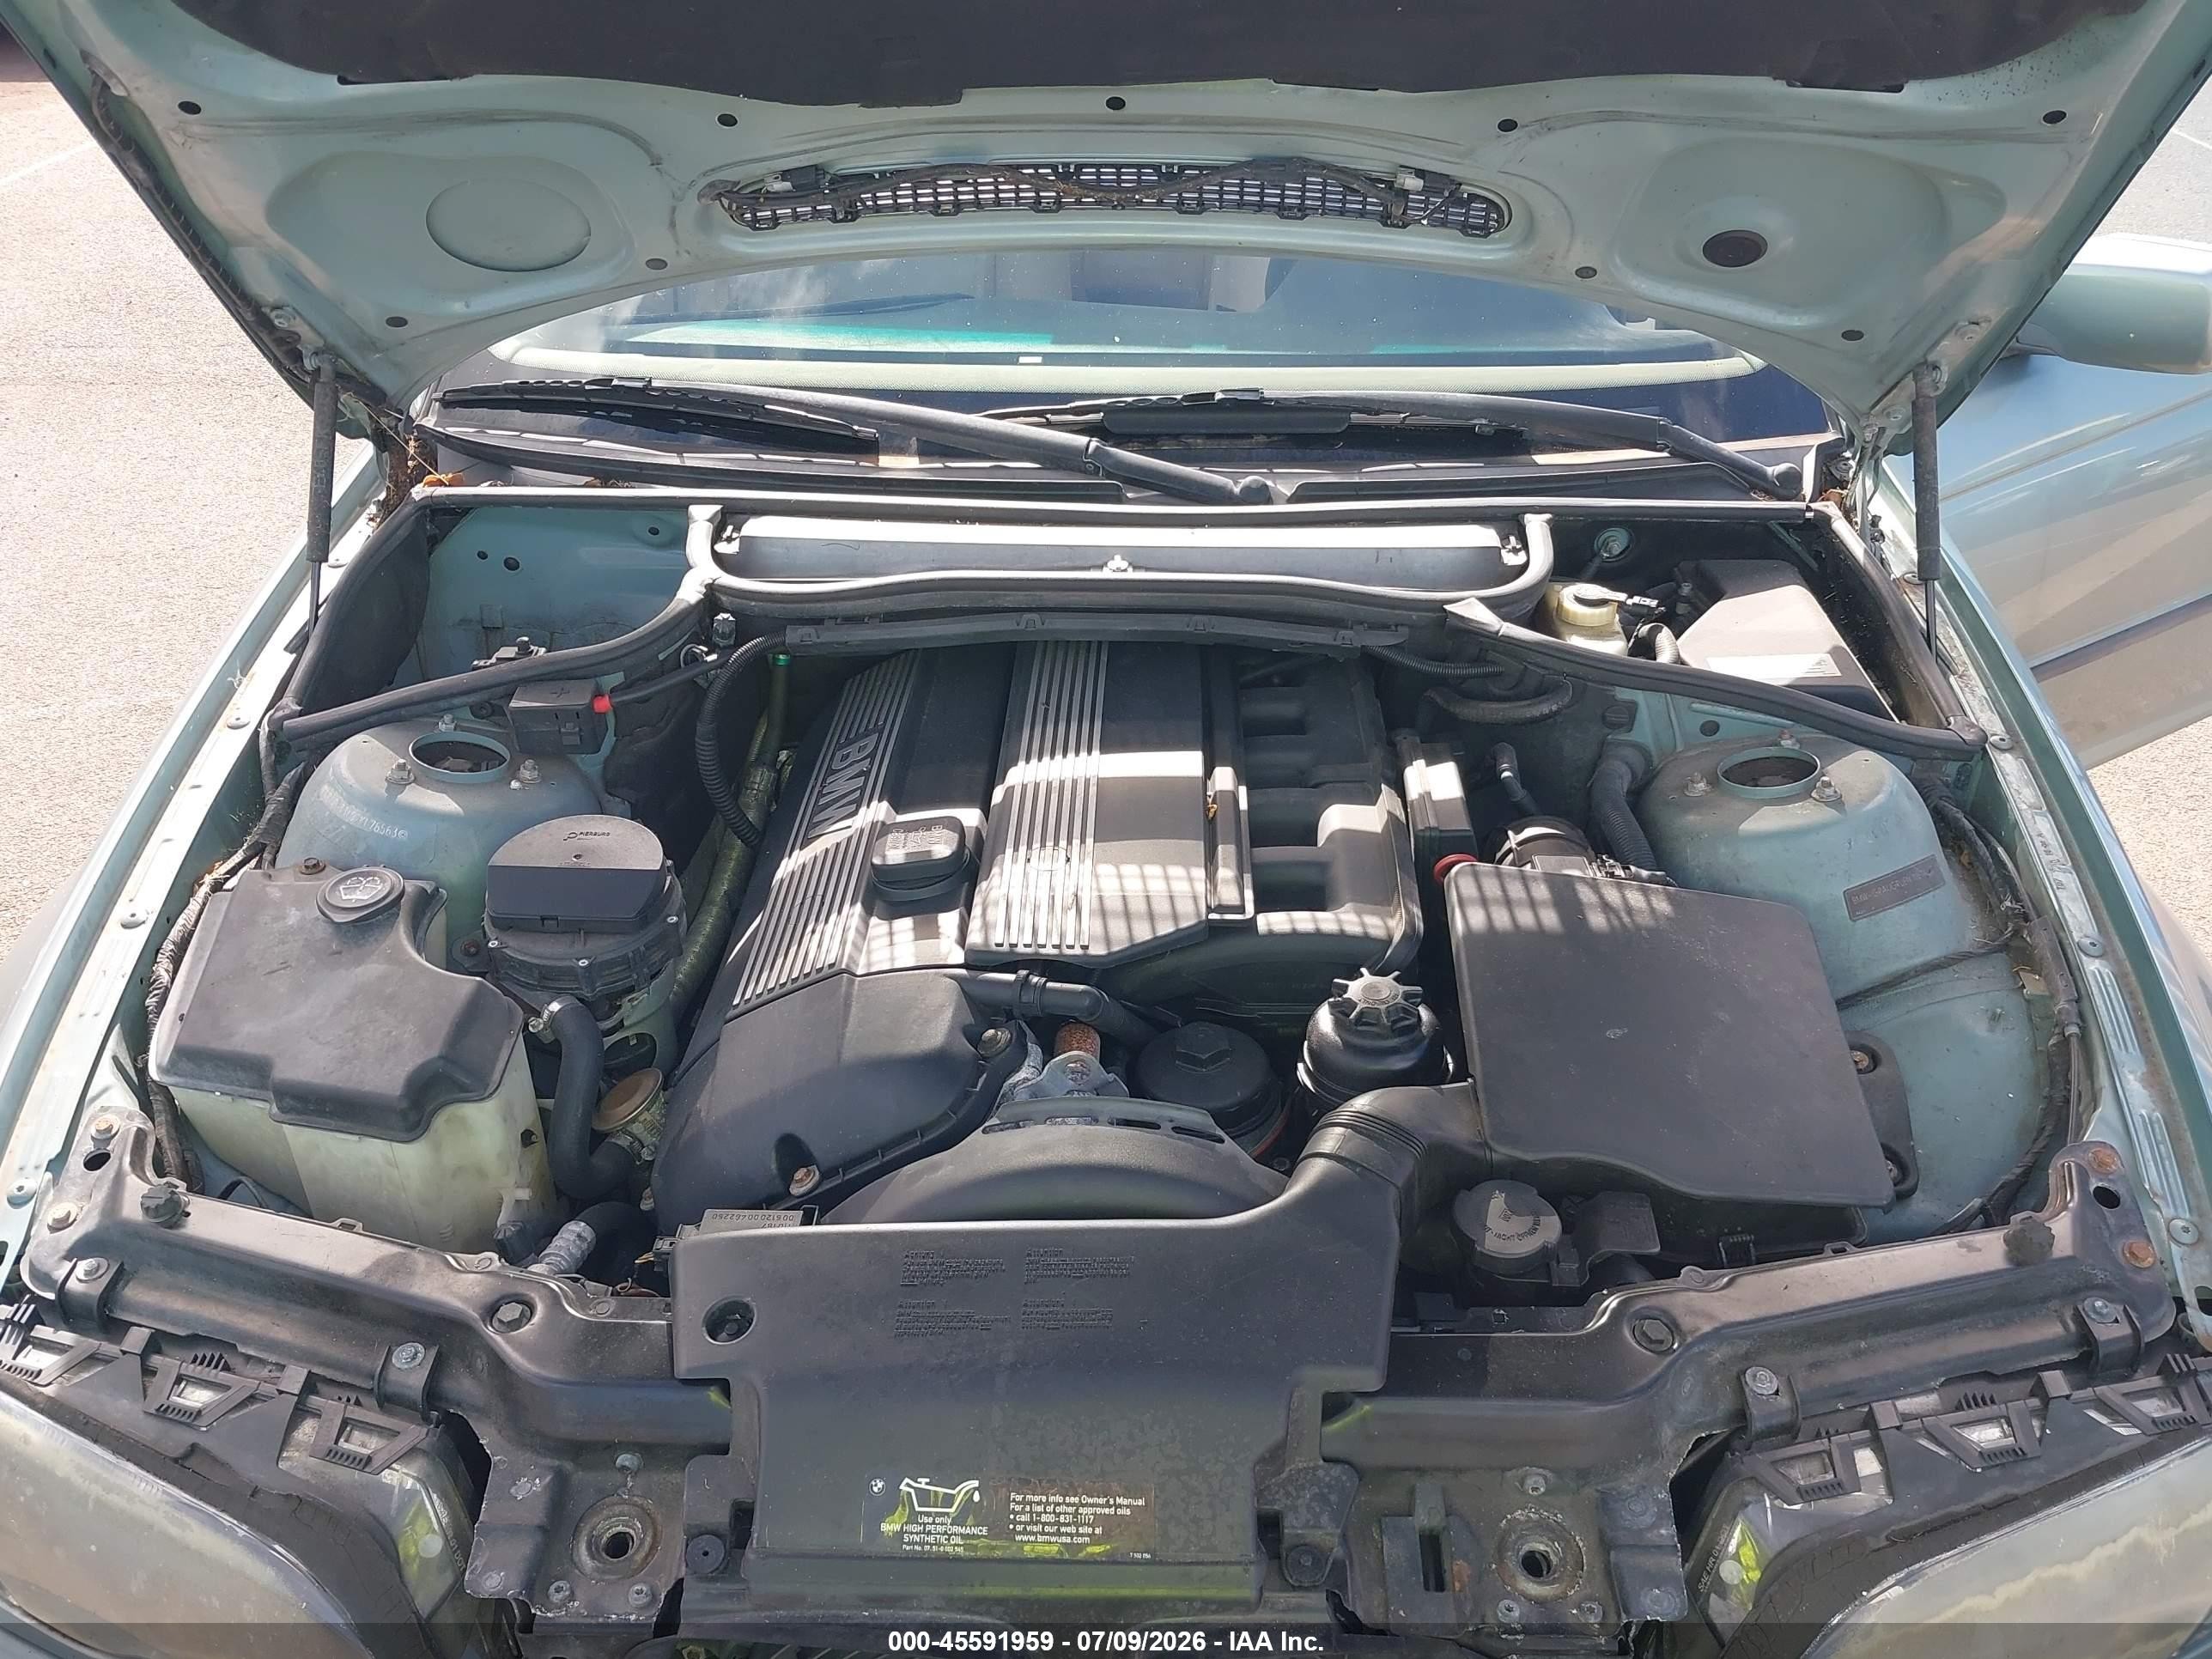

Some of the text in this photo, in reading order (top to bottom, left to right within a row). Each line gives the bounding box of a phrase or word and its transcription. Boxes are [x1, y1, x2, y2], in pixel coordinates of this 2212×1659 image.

[807, 732, 879, 839] BMW
[1010, 1492, 1024, 1501] For
[1048, 1494, 1063, 1503] info
[1081, 1495, 1114, 1504] Owner's
[1116, 1497, 1146, 1506] Manual
[1010, 1503, 1024, 1511] For
[1032, 1504, 1044, 1512] list
[1046, 1504, 1054, 1512] of
[1055, 1504, 1077, 1513] other
[1078, 1505, 1115, 1515] approved
[1116, 1506, 1131, 1516] oils
[918, 1514, 952, 1525] Use only
[1016, 1513, 1094, 1524] call 1-800-831-1117
[880, 1522, 988, 1535] BMW HIGH PERFORMANCE
[1026, 1523, 1042, 1532] visit
[1060, 1524, 1077, 1534] web
[1078, 1525, 1092, 1534] site
[1094, 1526, 1103, 1534] at
[903, 1534, 963, 1545] SYNTHETIC OIL
[1015, 1534, 1091, 1544] www.bmwusa.com
[1698, 1570, 1710, 1593] SAE
